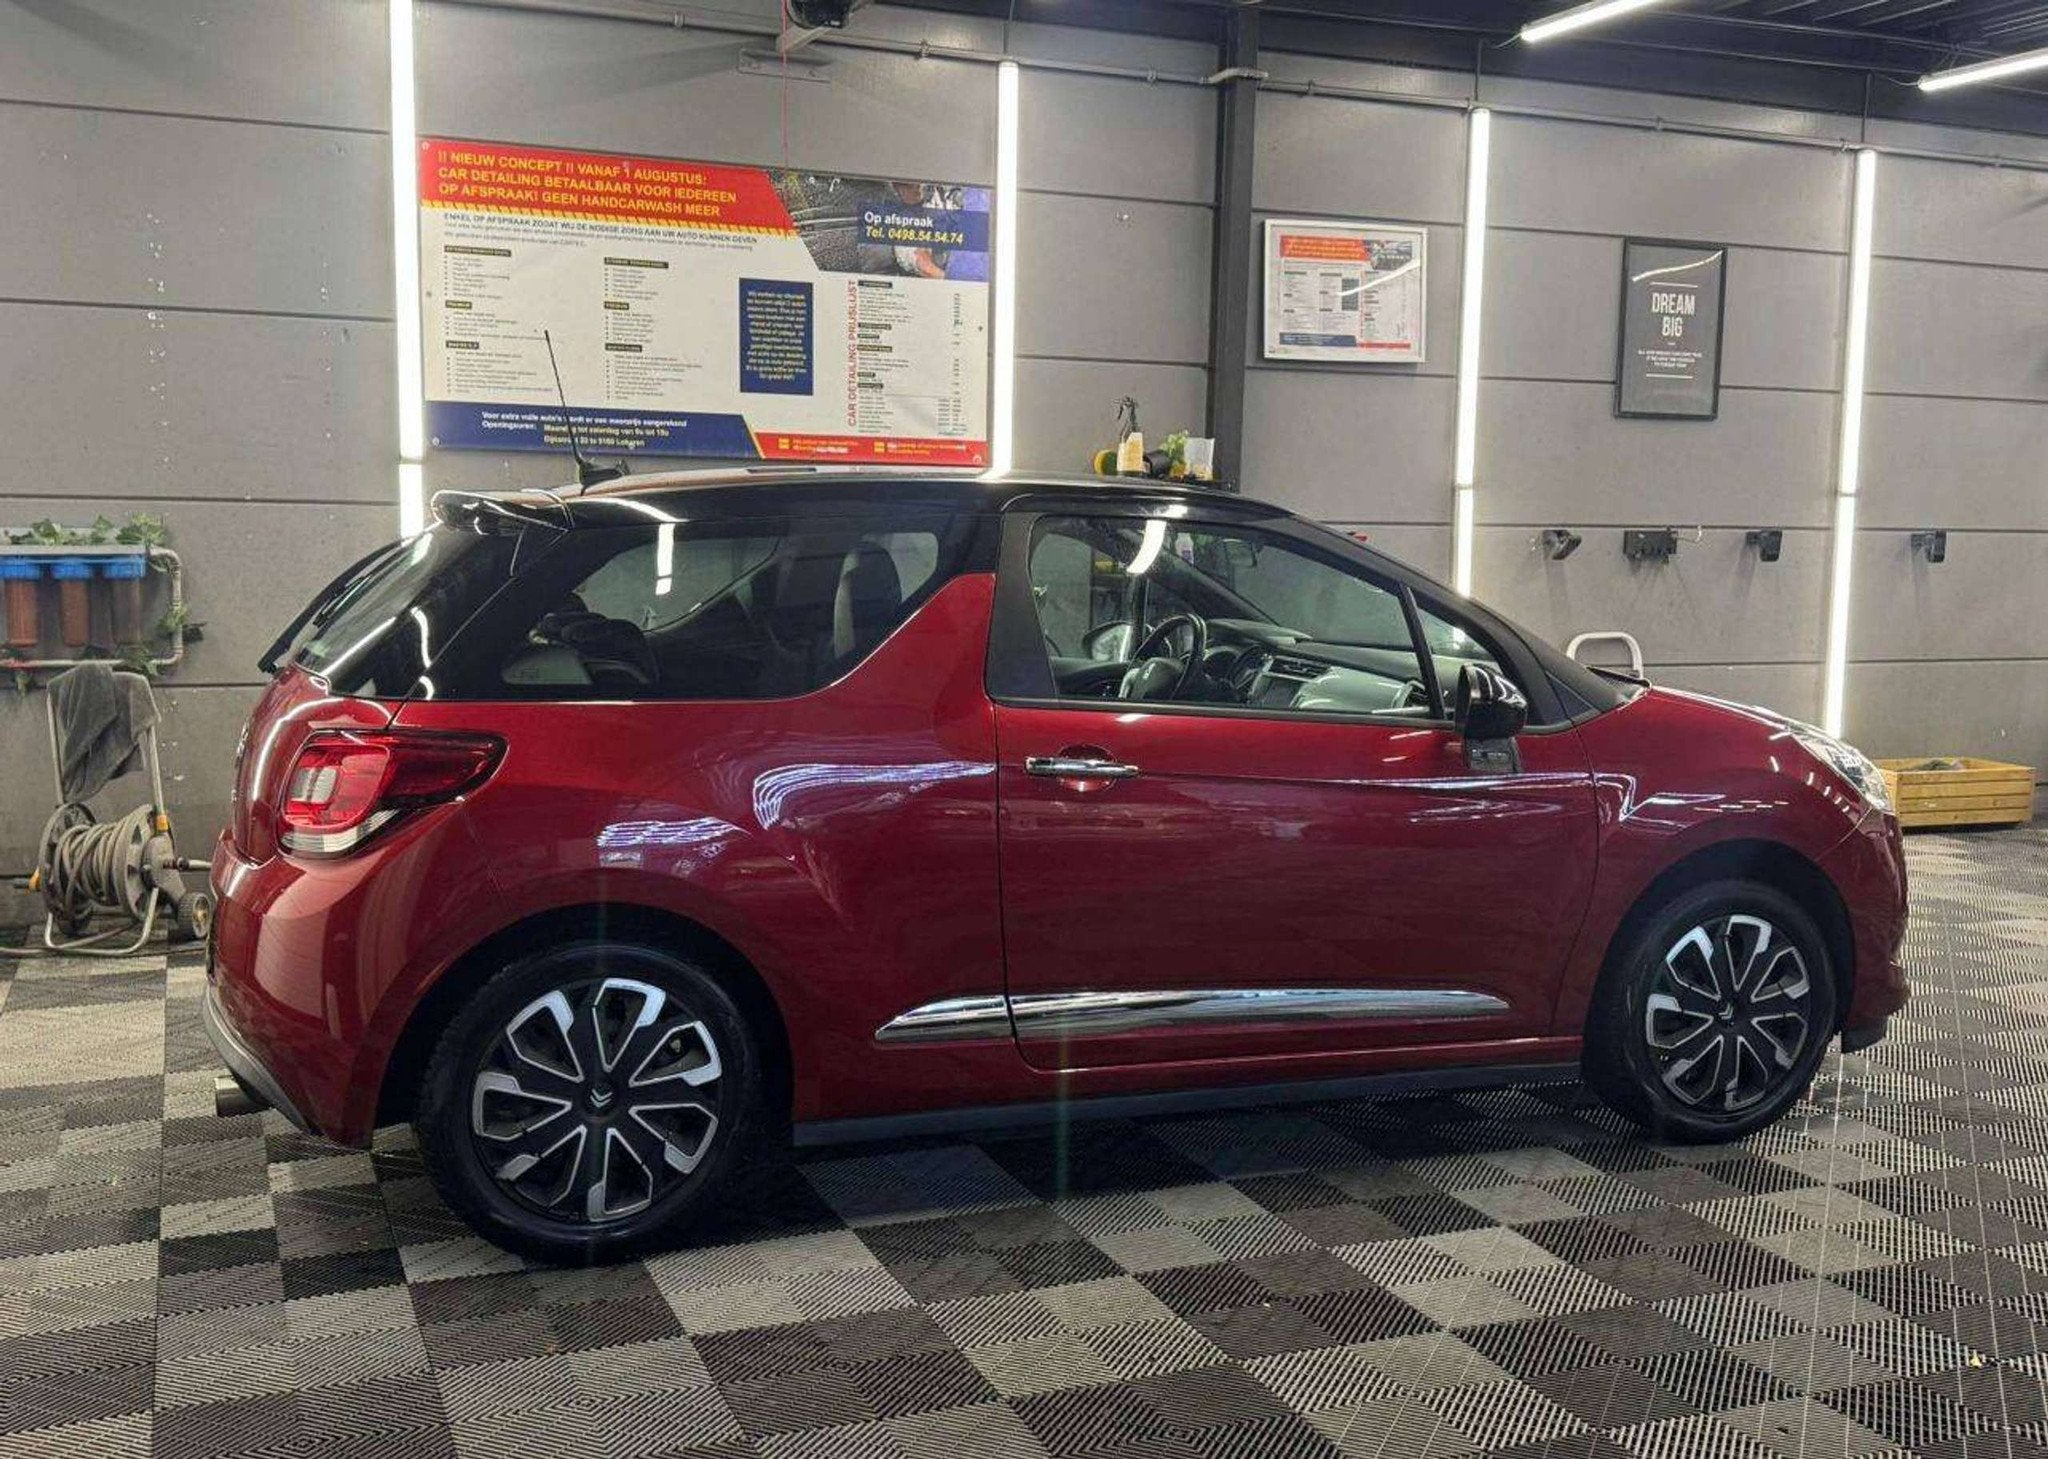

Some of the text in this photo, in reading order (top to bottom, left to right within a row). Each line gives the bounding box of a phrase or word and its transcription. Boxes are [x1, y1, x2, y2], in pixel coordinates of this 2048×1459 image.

[451, 152, 496, 166] NIEUW
[500, 156, 562, 172] CONCEPT
[578, 163, 620, 178] VANAF
[634, 169, 708, 185] AUGUSTUS:
[438, 167, 737, 203] CAR DETAILING BETAALBAAR VOOR IEDEREEN
[439, 183, 459, 196] OP
[542, 191, 579, 205] GEEN
[582, 196, 683, 214] HANDCARWASH
[685, 203, 721, 217] MEER
[473, 214, 485, 222] OP
[486, 215, 531, 227] AFSPRAAK
[532, 219, 558, 229] ZODAT
[561, 221, 575, 230] WIJ
[576, 223, 586, 231] DE
[644, 227, 661, 237] AAN
[662, 229, 675, 237] UW
[676, 230, 699, 240] AUTO
[864, 211, 934, 228] Op afspraak
[865, 226, 964, 245] Tel. 0498.54.54.74
[1652, 293, 1696, 315] DREAM
[1662, 316, 1683, 337] BIG
[847, 281, 858, 426] CAR DETAILING PRIJSLIJST
[481, 411, 500, 420] Voor
[501, 413, 520, 421] extra
